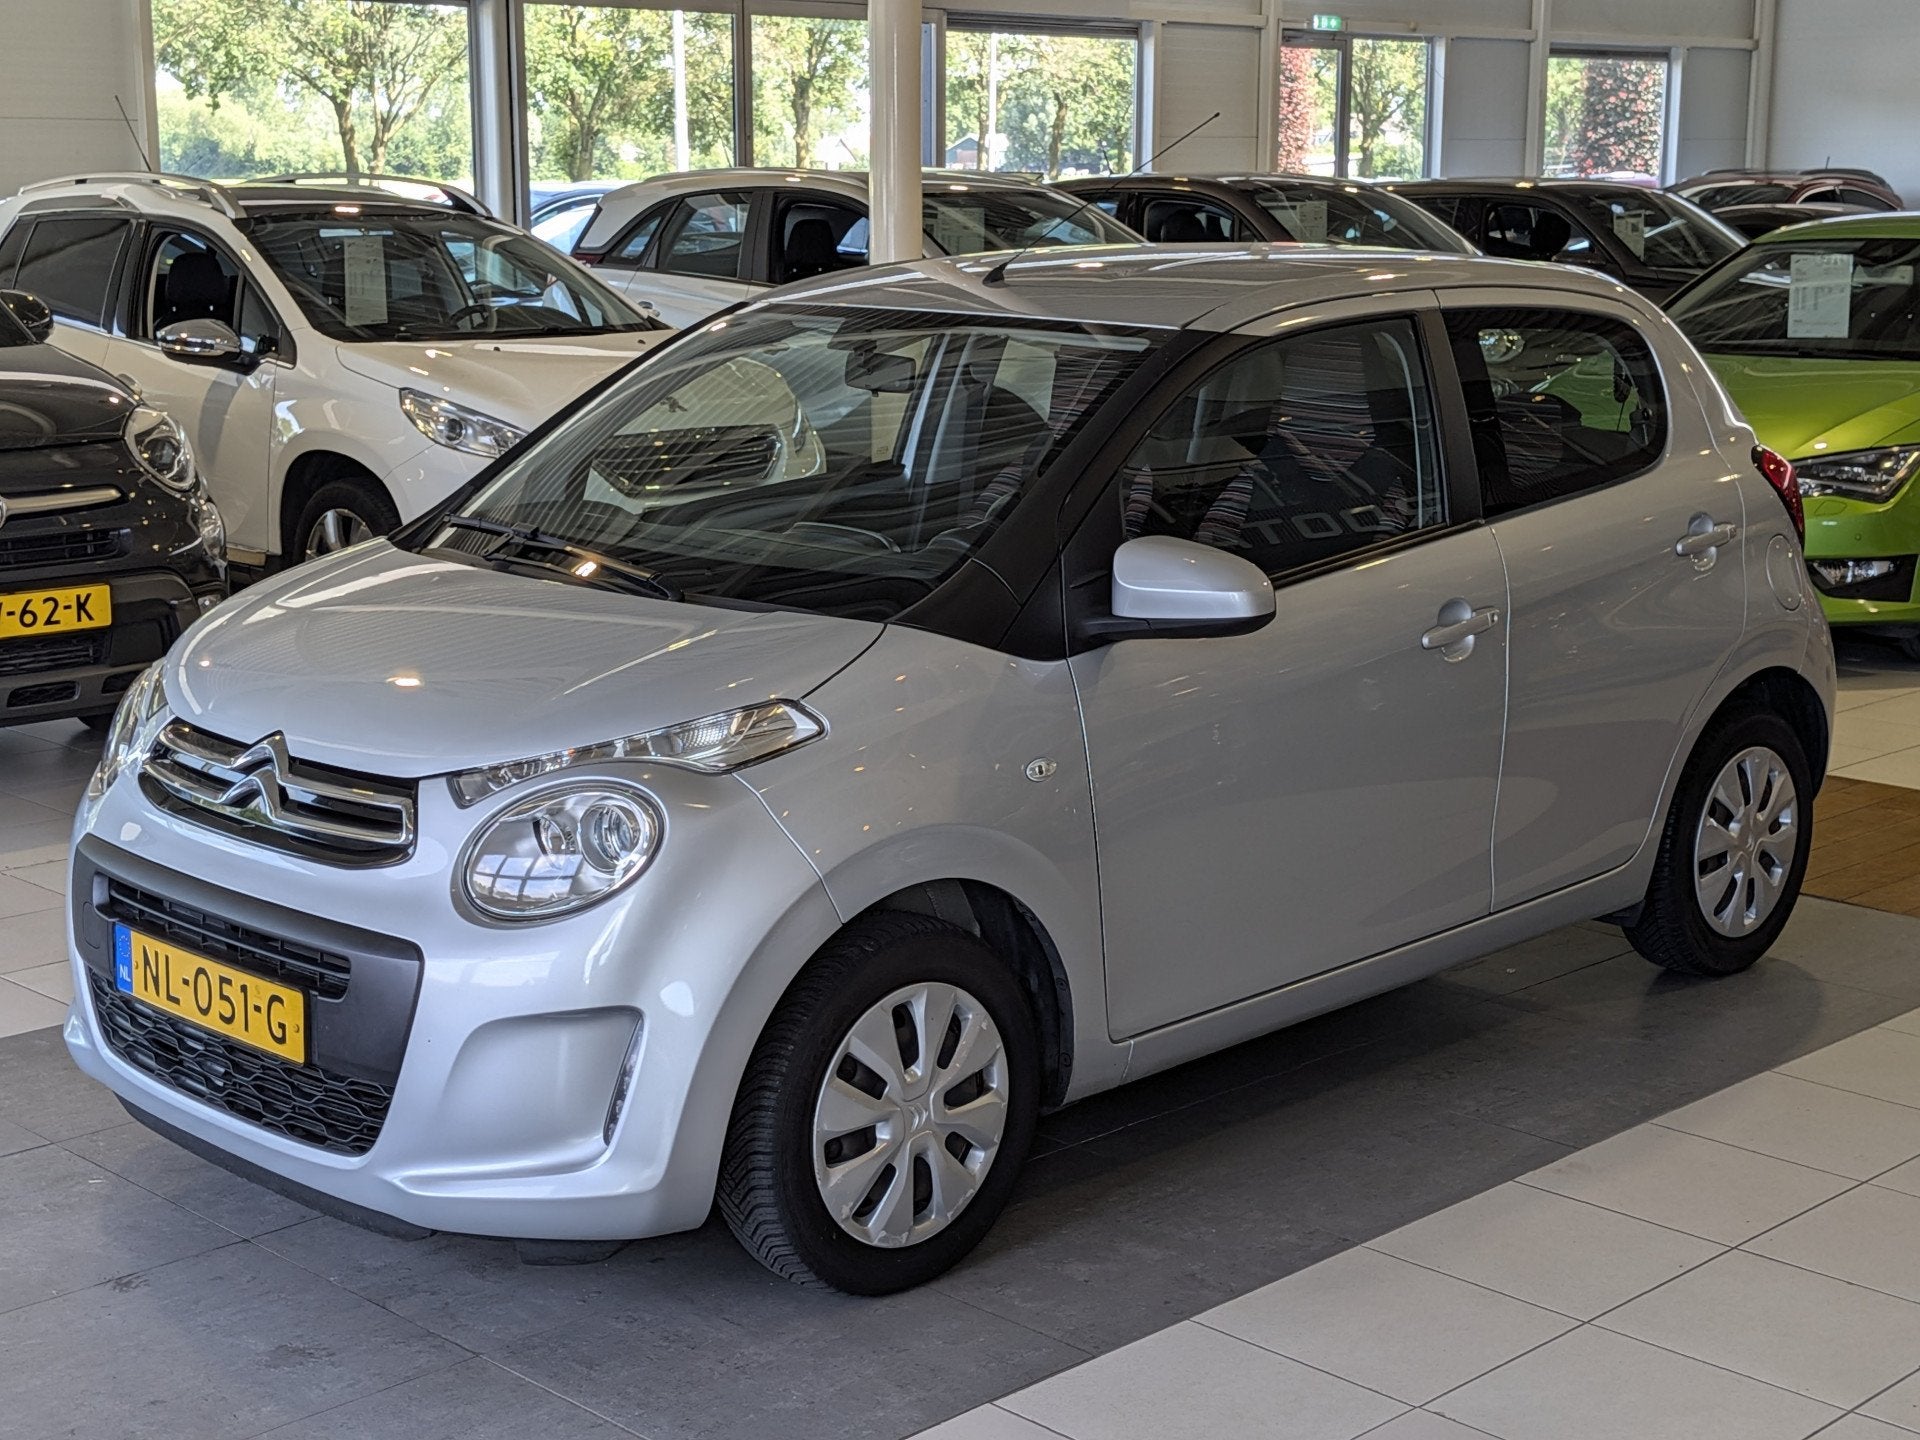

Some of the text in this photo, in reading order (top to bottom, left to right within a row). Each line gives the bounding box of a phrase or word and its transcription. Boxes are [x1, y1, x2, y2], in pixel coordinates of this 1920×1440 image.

[0, 592, 95, 629] -62-K
[118, 963, 131, 983] NL
[142, 944, 288, 1046] NL-051-G
